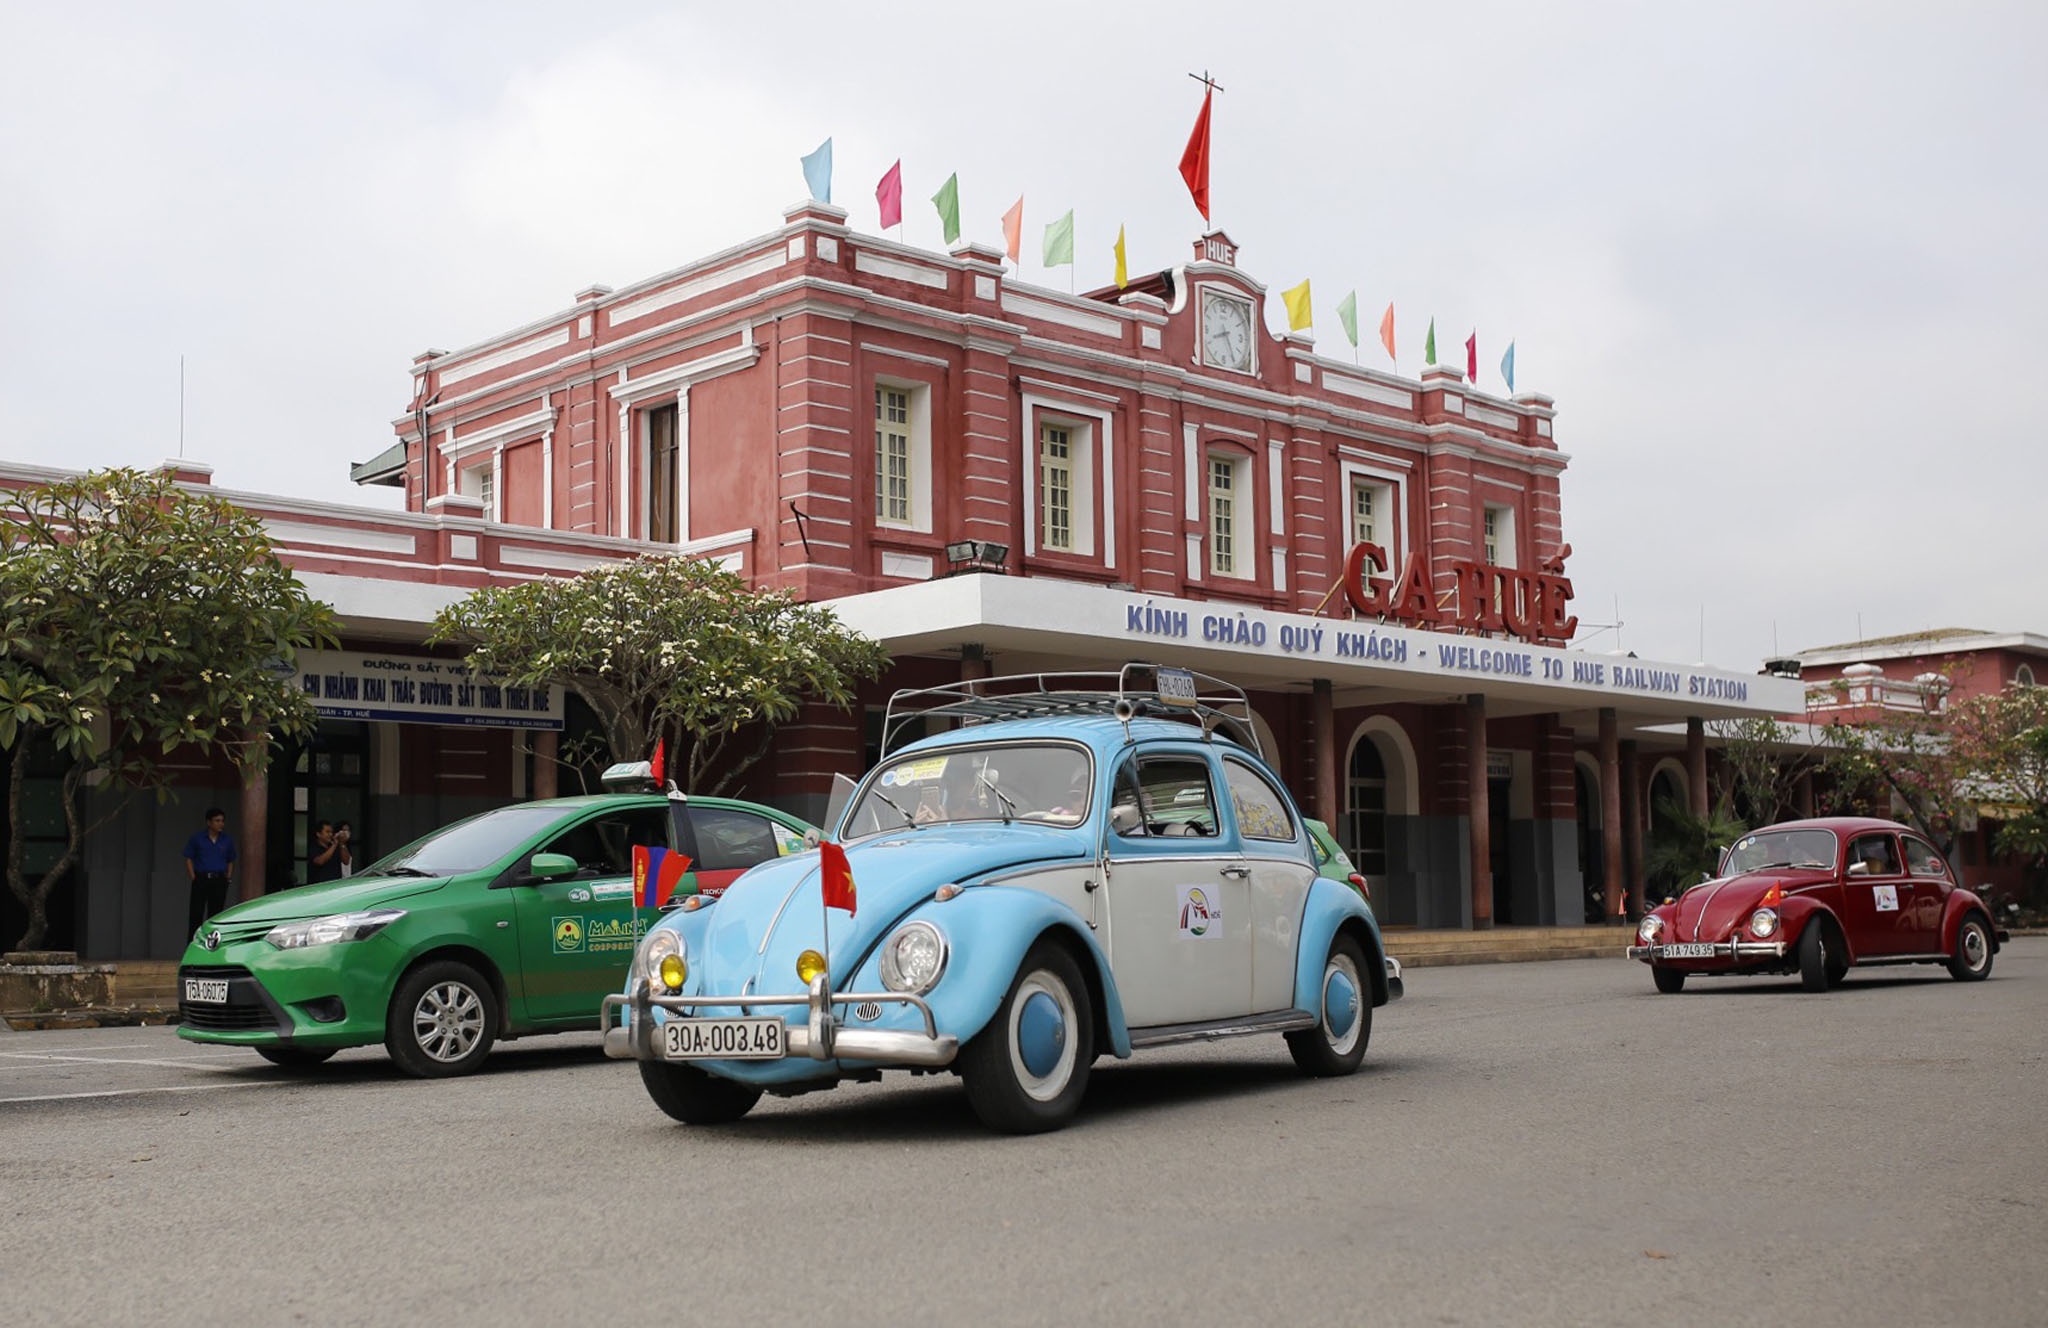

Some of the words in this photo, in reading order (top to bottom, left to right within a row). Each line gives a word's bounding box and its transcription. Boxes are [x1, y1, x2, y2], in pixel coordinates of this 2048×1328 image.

[1207, 239, 1233, 266] HUE
[1343, 541, 1443, 622] GA
[1452, 543, 1578, 640] HUẾ
[363, 658, 411, 671] ĐƯỜNG
[416, 662, 442, 674] SẮT
[1127, 600, 1188, 638] KÍNH
[1202, 611, 1267, 647] CHÀO
[1279, 622, 1324, 653] QUÝ
[1336, 629, 1407, 663] KHÁCH
[1438, 644, 1532, 677] WELCOME
[1541, 656, 1564, 680] TO
[1573, 660, 1605, 685] HUE
[1612, 666, 1680, 694] RAILWAY
[1689, 675, 1748, 701] STATION
[303, 673, 321, 699] CHI
[324, 671, 359, 701] NHÁNH
[363, 677, 387, 703] KHAI
[391, 675, 415, 704] THÁC
[419, 678, 453, 706] ĐƯỜNG
[457, 678, 476, 708] SẮT
